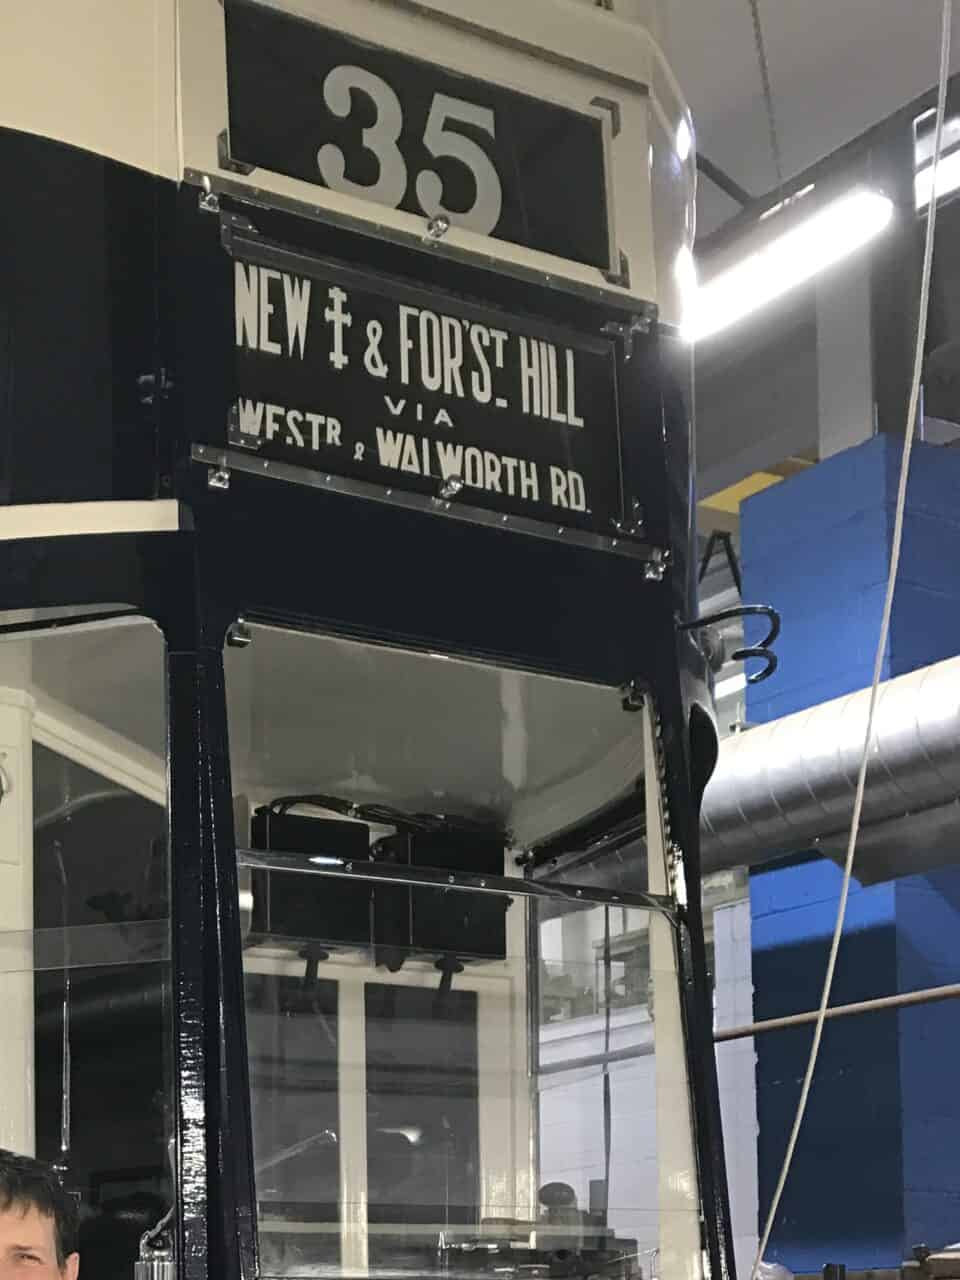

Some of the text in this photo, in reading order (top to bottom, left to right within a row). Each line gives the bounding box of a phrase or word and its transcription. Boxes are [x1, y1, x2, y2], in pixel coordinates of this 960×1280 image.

[317, 65, 502, 236] 35
[234, 261, 312, 361] NEW
[363, 319, 389, 379] &
[519, 336, 585, 428] HILL
[384, 395, 454, 428] VIA
